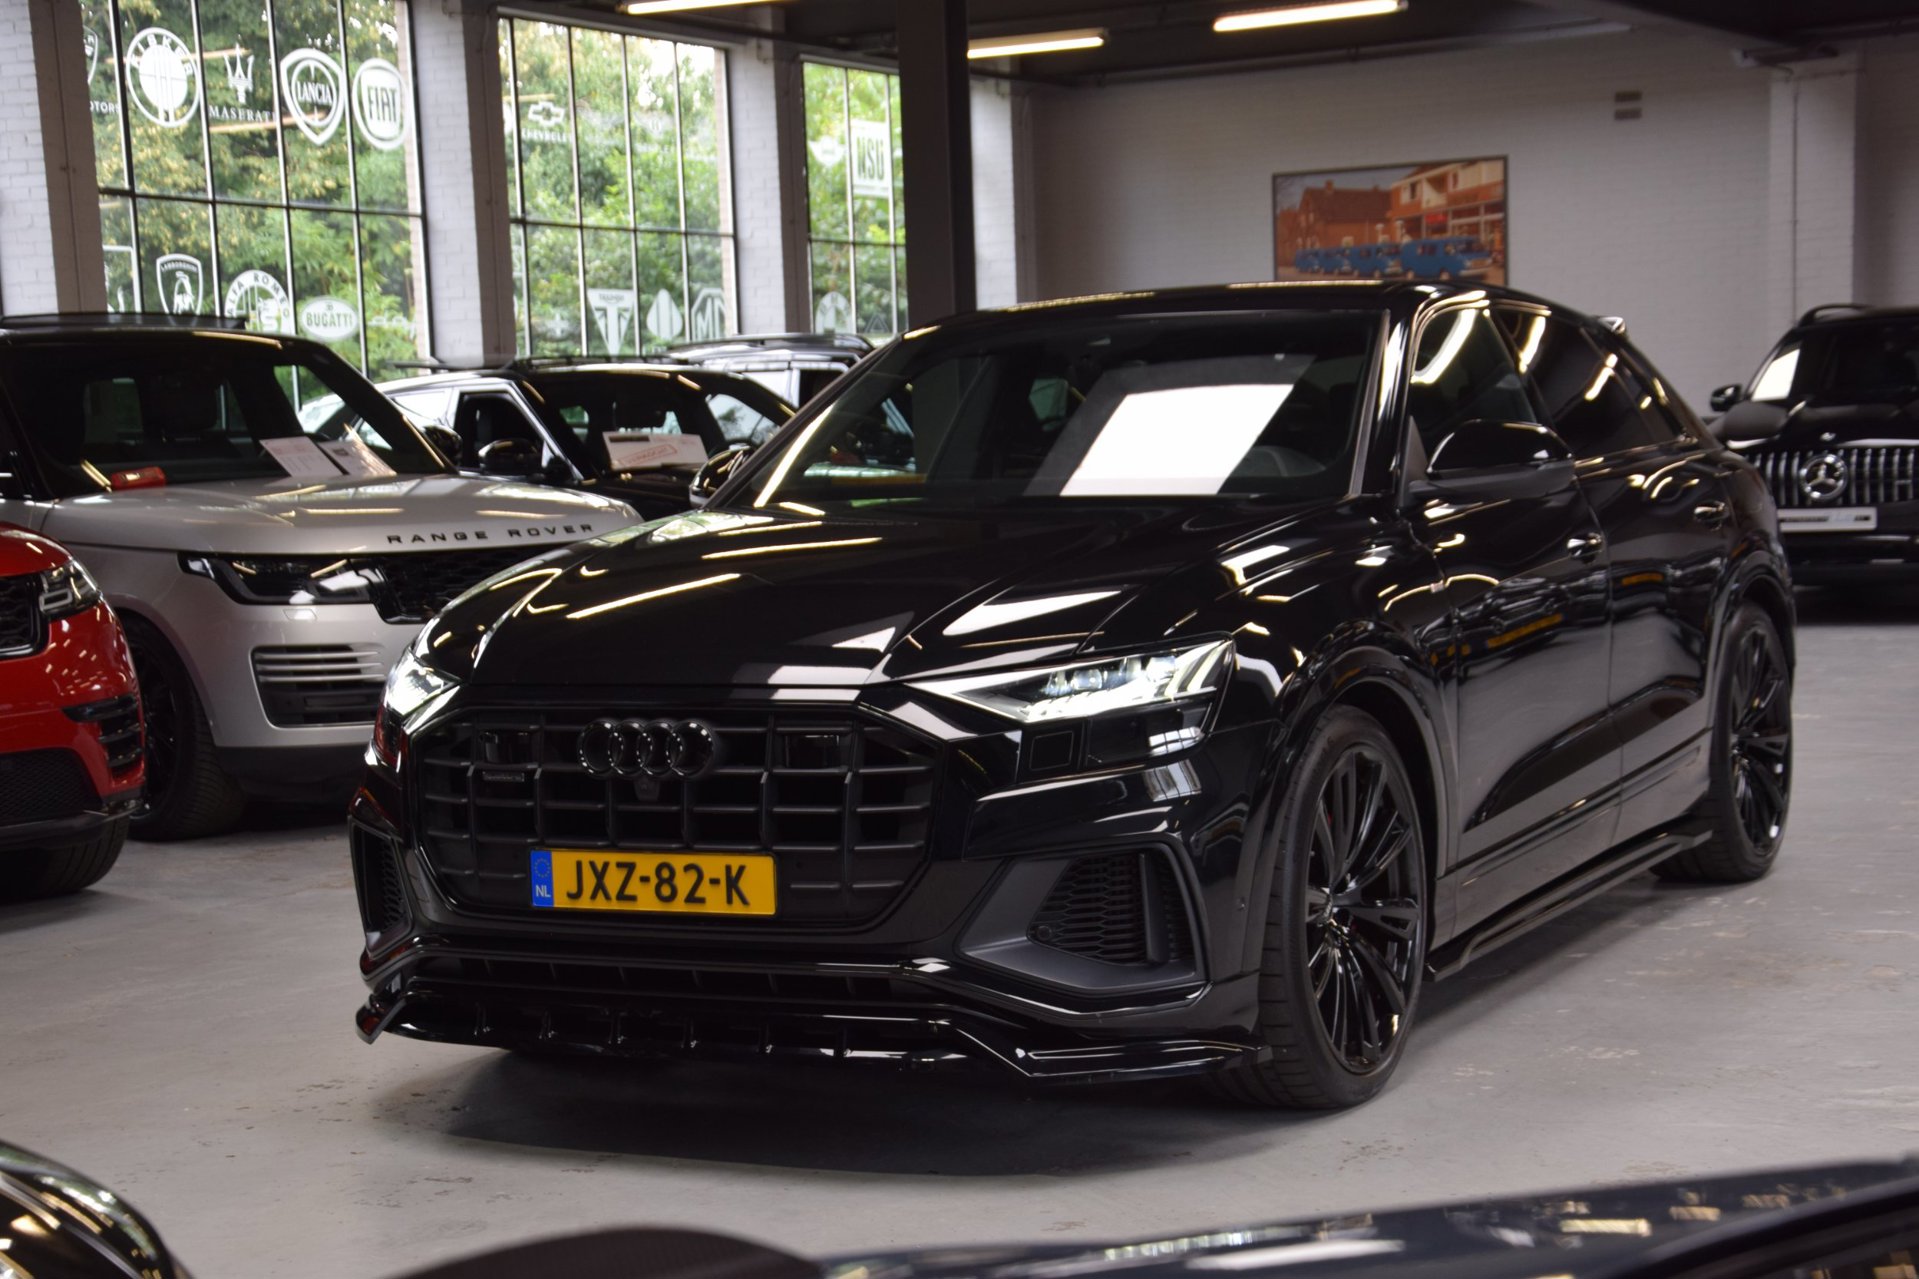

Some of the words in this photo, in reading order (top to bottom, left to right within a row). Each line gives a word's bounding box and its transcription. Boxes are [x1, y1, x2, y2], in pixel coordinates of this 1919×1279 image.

[296, 80, 334, 106] LANCIA
[367, 85, 398, 122] FIAT
[856, 136, 885, 180] NSU
[253, 271, 291, 318] ROMEO
[305, 311, 354, 329] BUGATTI
[386, 530, 489, 545] RANGE
[507, 523, 595, 538] ROVER
[535, 884, 552, 898] NL
[566, 859, 751, 906] JXZ-82-K
